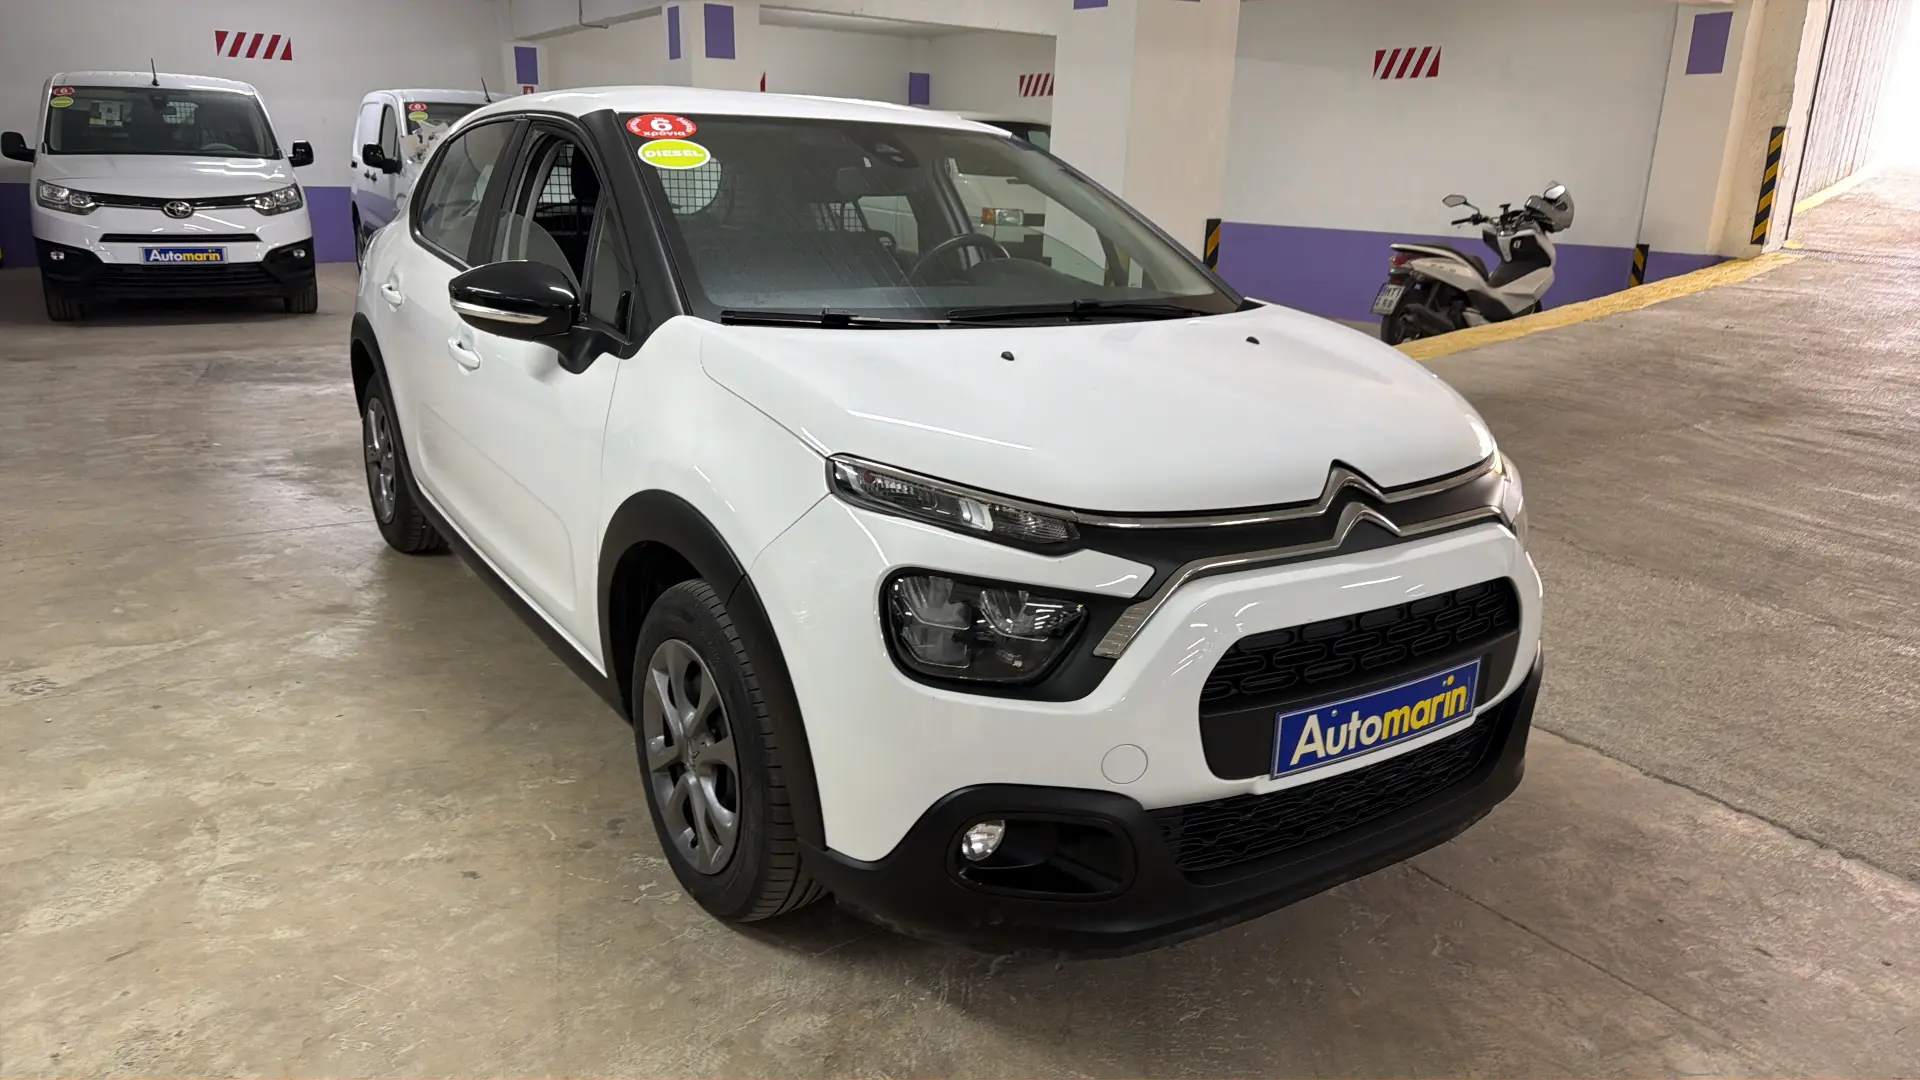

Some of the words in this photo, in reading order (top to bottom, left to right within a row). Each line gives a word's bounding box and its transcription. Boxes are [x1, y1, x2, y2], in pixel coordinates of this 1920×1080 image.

[650, 119, 673, 131] 6
[644, 149, 704, 158] DIESEL
[149, 249, 221, 261] Automarin
[1290, 675, 1467, 766] Automarin
